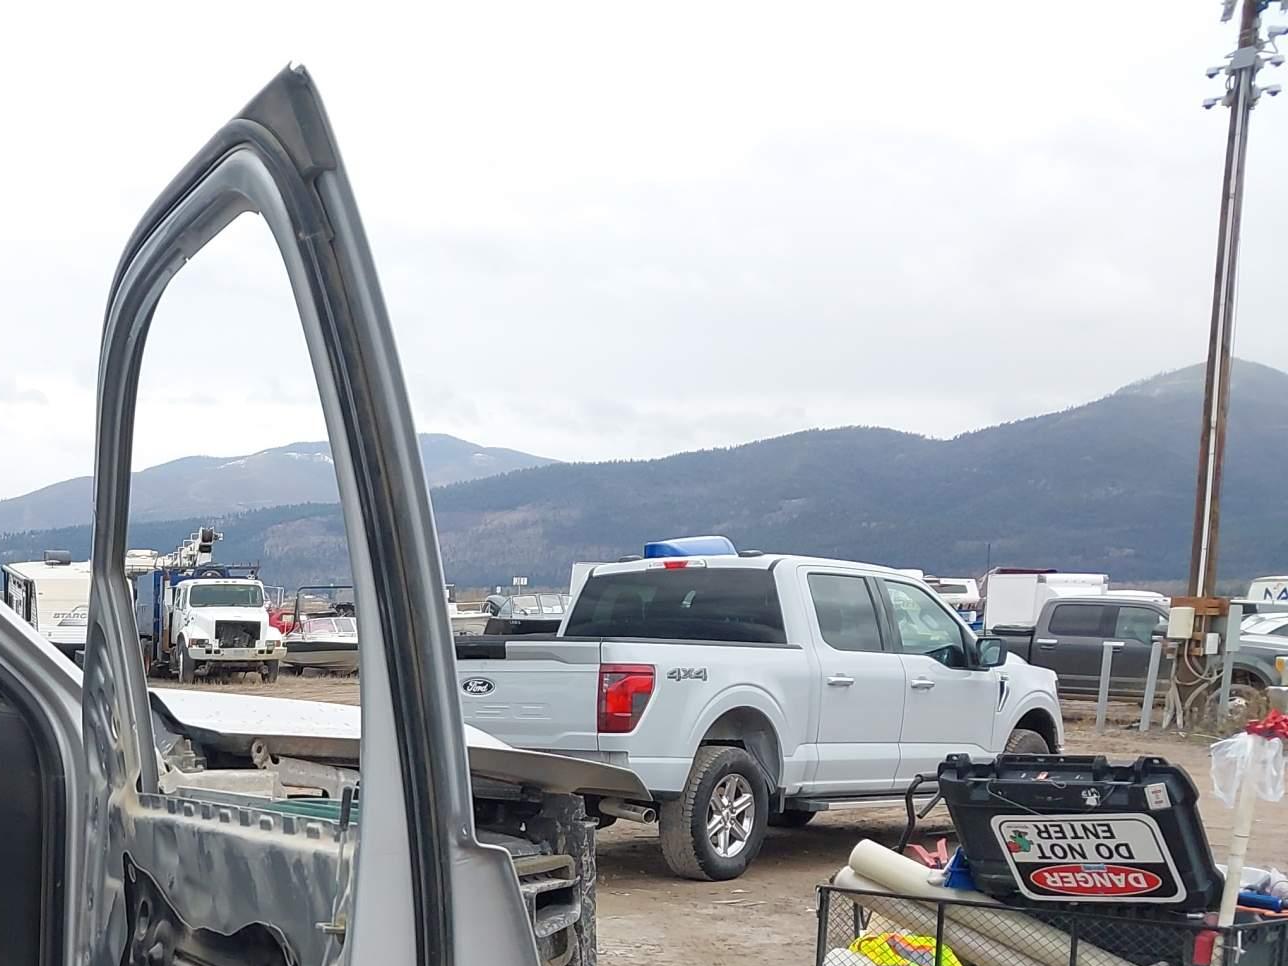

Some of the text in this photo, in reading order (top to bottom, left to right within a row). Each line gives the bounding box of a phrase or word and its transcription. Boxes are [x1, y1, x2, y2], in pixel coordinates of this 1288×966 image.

[466, 679, 490, 692] Ford
[1033, 823, 1116, 840] ENTER
[1038, 843, 1135, 860] DO NOT
[1044, 872, 1149, 888] DANGER
